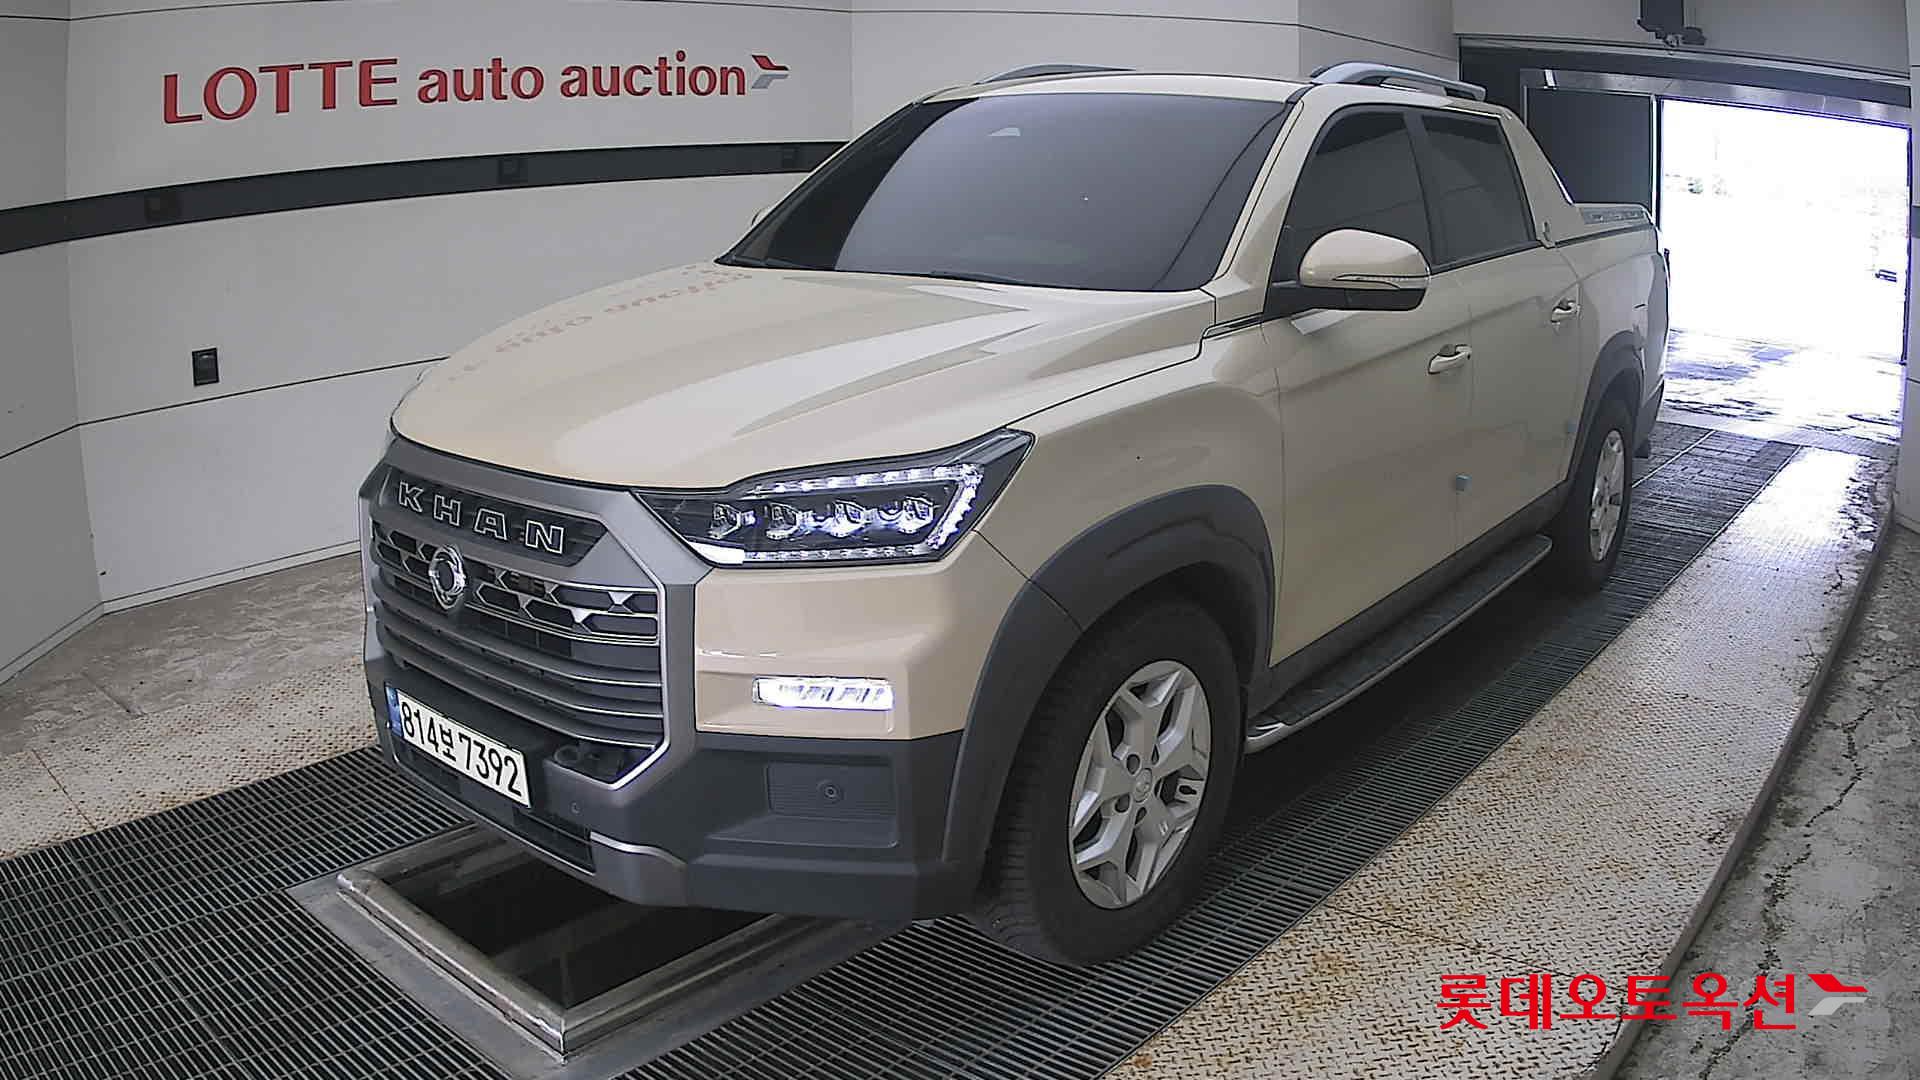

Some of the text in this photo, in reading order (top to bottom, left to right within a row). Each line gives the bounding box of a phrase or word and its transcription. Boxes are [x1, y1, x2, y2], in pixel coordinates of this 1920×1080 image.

[163, 50, 747, 124] LOTTE auto auction
[398, 481, 565, 554] KHAN
